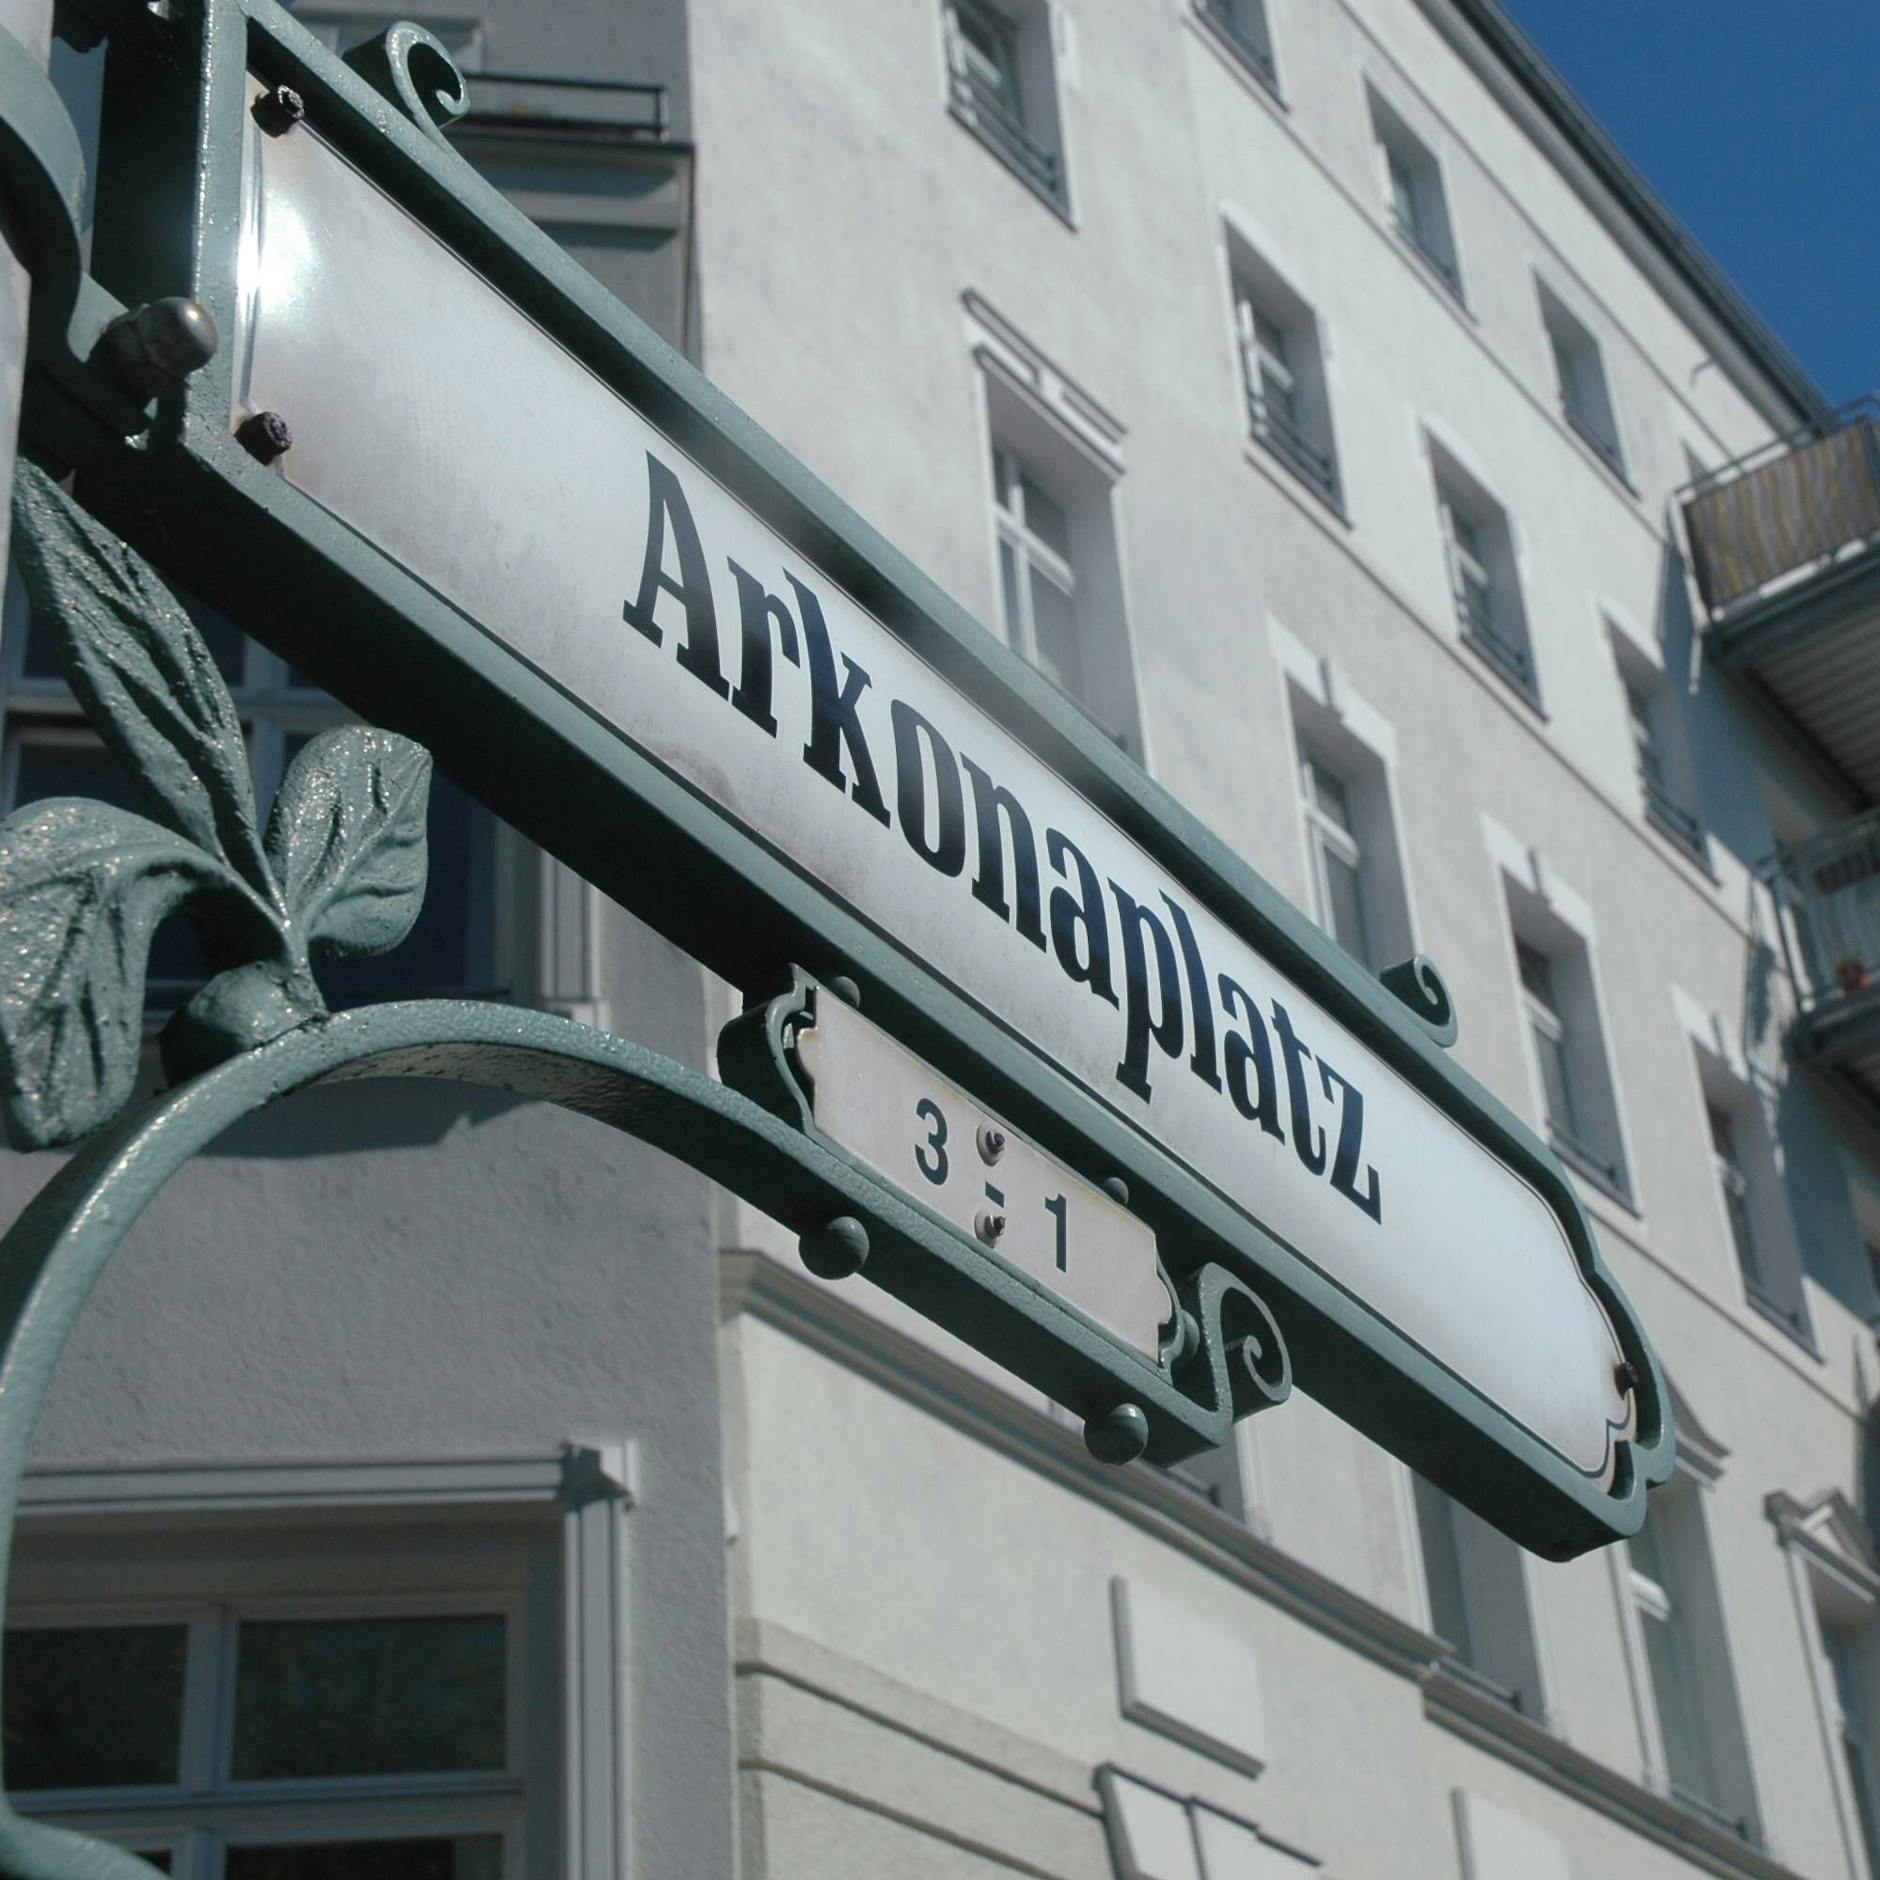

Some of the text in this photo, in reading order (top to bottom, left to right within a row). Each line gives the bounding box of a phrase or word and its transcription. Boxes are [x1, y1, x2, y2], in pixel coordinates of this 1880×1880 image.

[623, 451, 1382, 1225] Arkonaplatz
[915, 1098, 949, 1186] 3
[1045, 1193, 1067, 1273] 1
